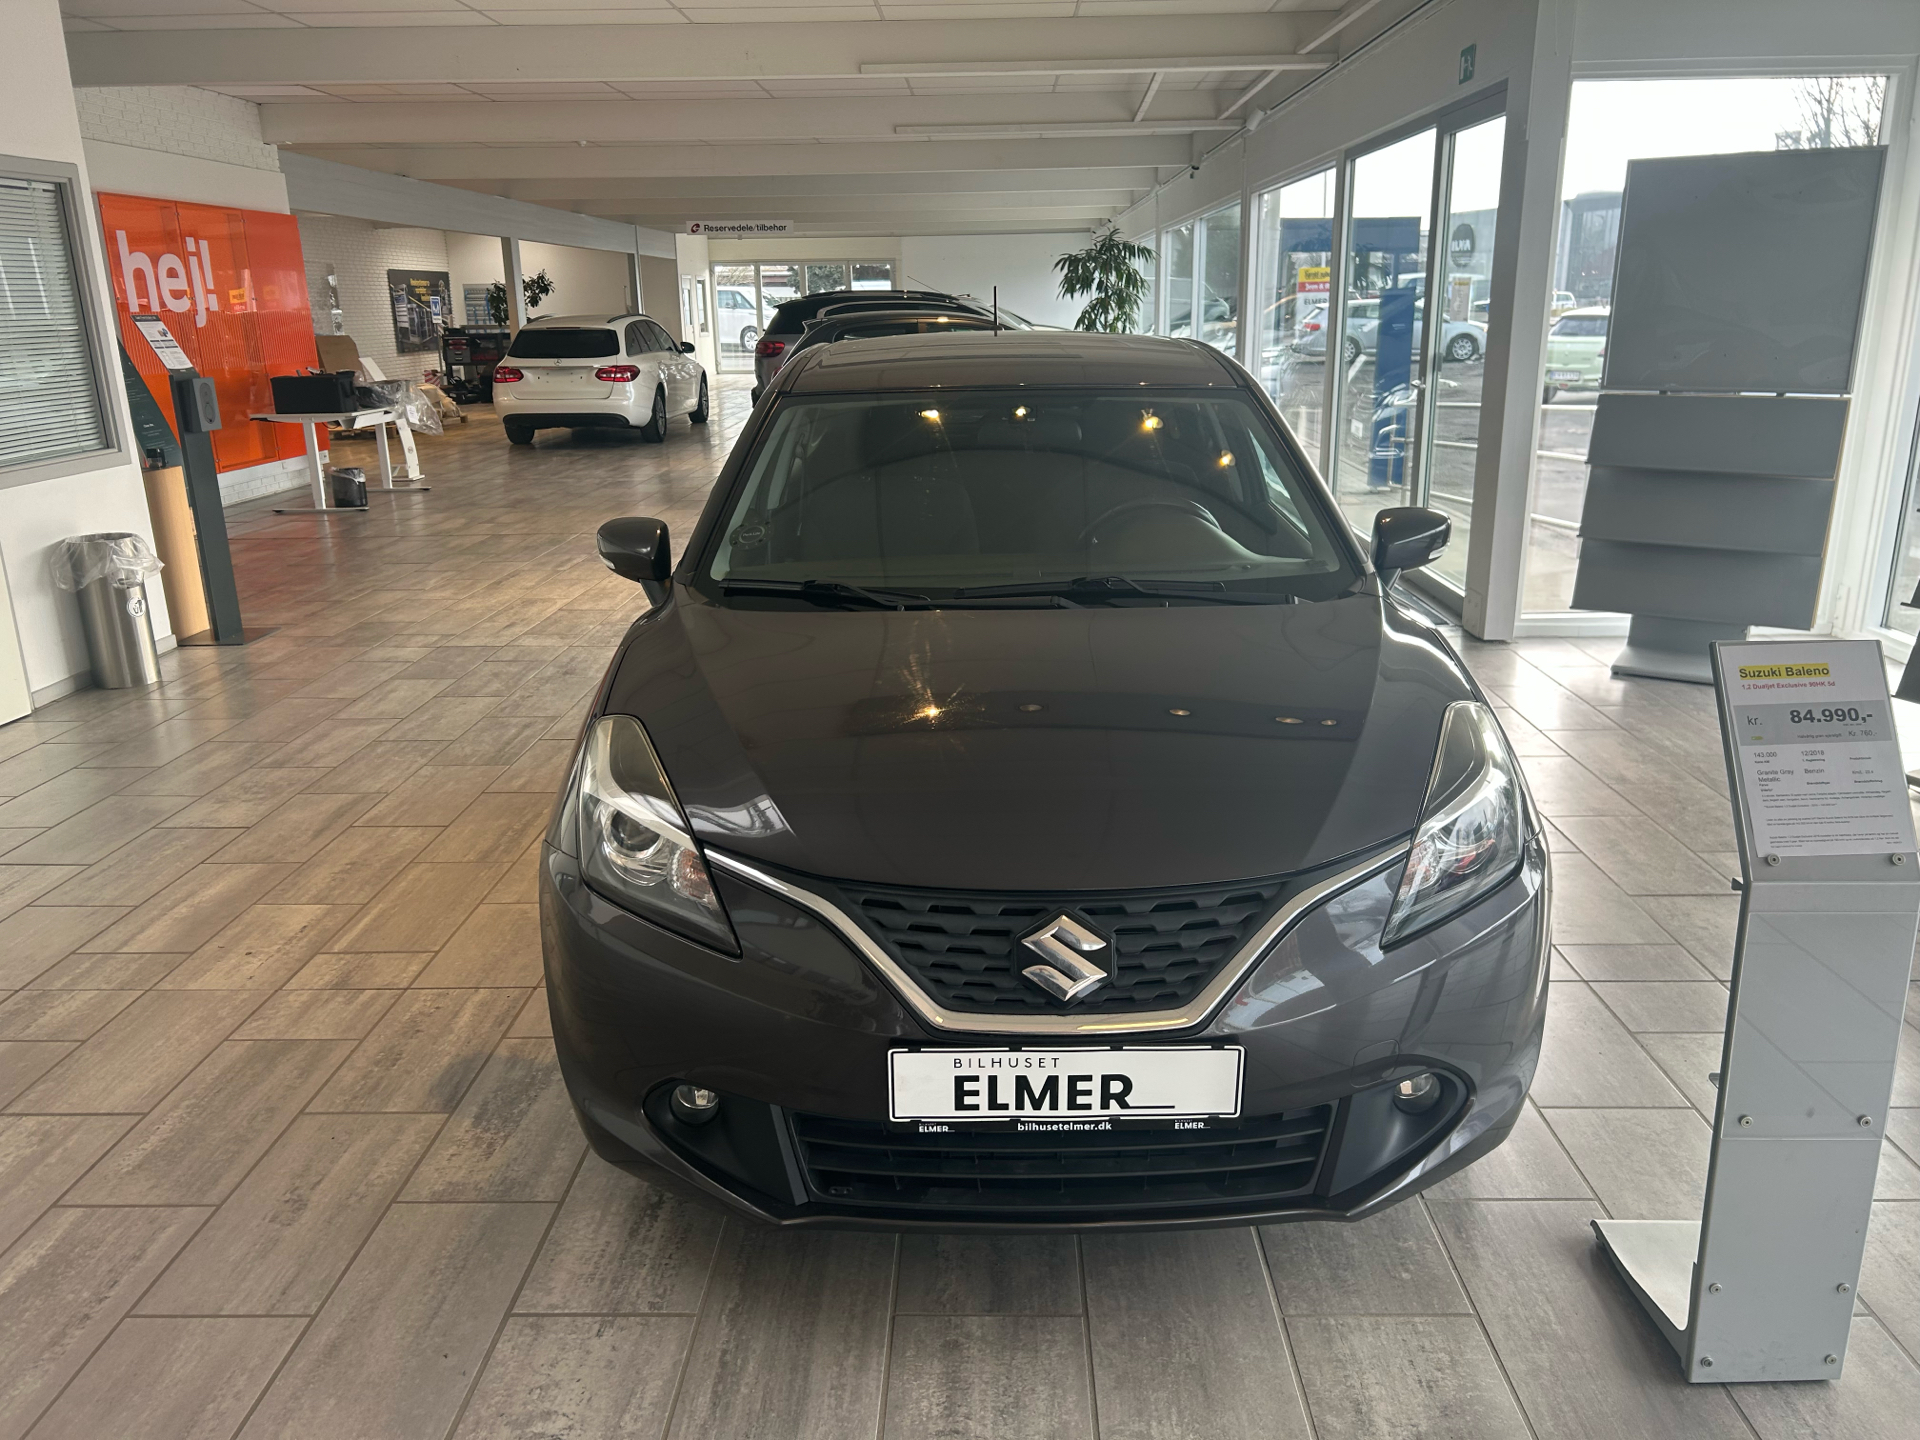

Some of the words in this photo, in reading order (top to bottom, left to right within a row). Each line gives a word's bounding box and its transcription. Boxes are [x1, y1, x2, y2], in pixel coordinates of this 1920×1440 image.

[116, 230, 219, 328] hej!
[1739, 667, 1782, 678] Suzuki
[1785, 666, 1830, 676] Baleno
[1747, 715, 1763, 726] kr.
[1790, 708, 1872, 724] 84.990,-
[953, 1057, 1060, 1069] BILHUSET
[954, 1074, 1175, 1111] ELMER
[1017, 1122, 1112, 1131] bilhusetelmer.dk
[1174, 1122, 1211, 1130] ELMER
